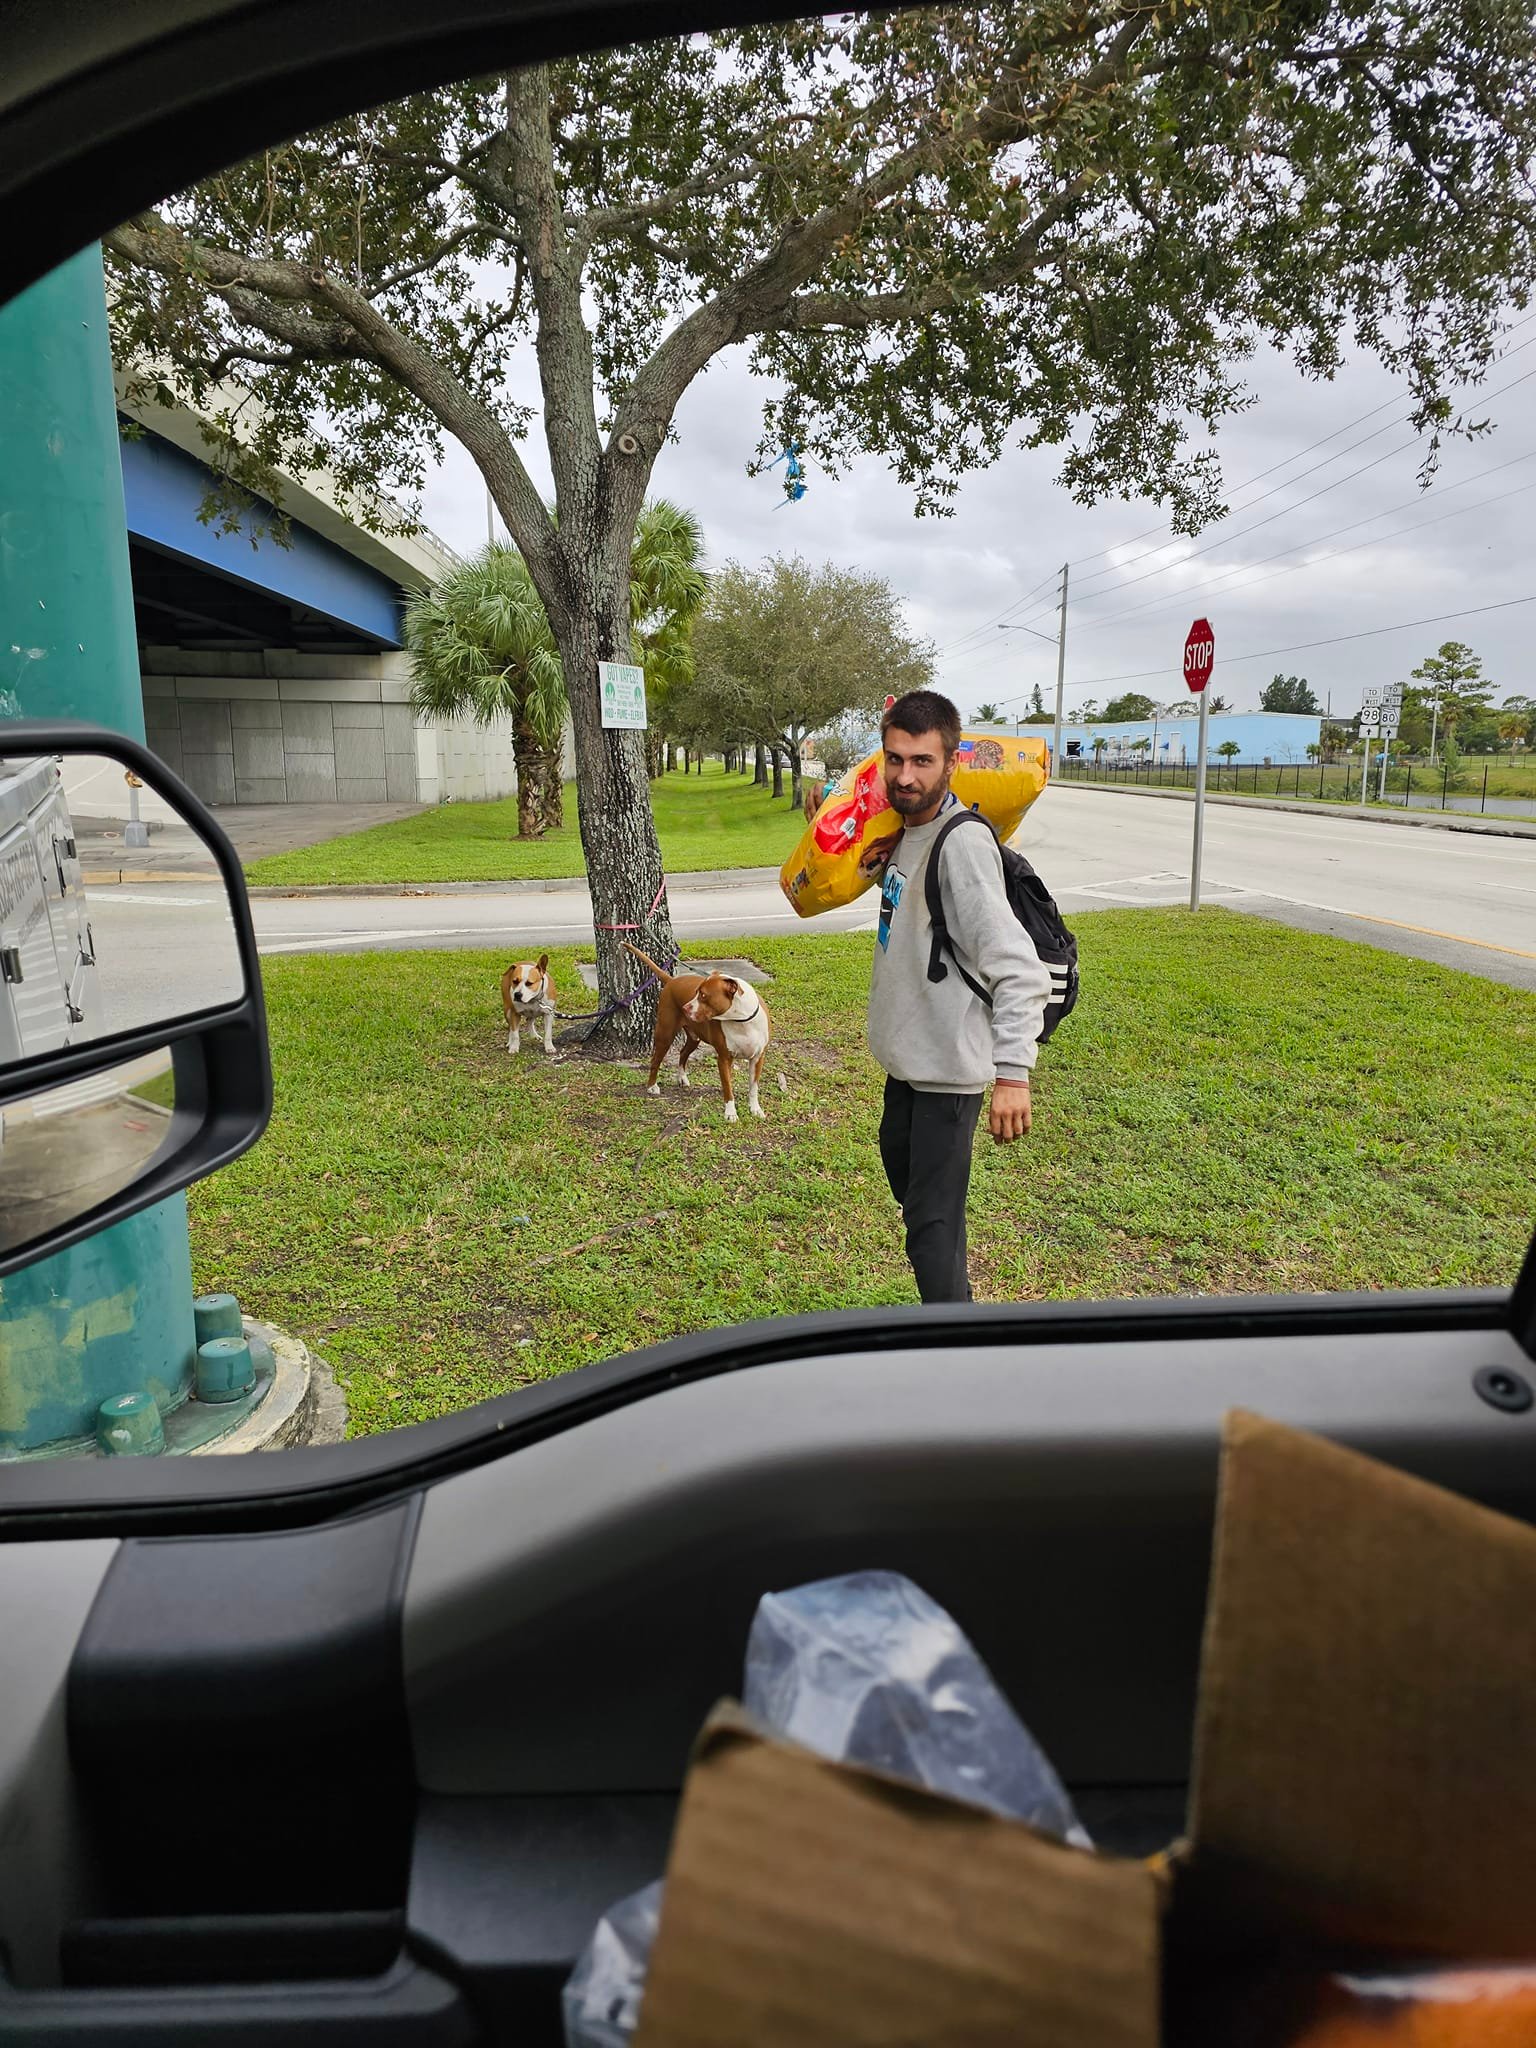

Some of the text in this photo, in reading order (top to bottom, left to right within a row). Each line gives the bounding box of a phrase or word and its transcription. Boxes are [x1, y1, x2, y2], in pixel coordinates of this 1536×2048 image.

[1185, 641, 1213, 671] STOP
[607, 664, 618, 681] GOT
[1364, 710, 1378, 720] 98
[1382, 713, 1395, 722] 80
